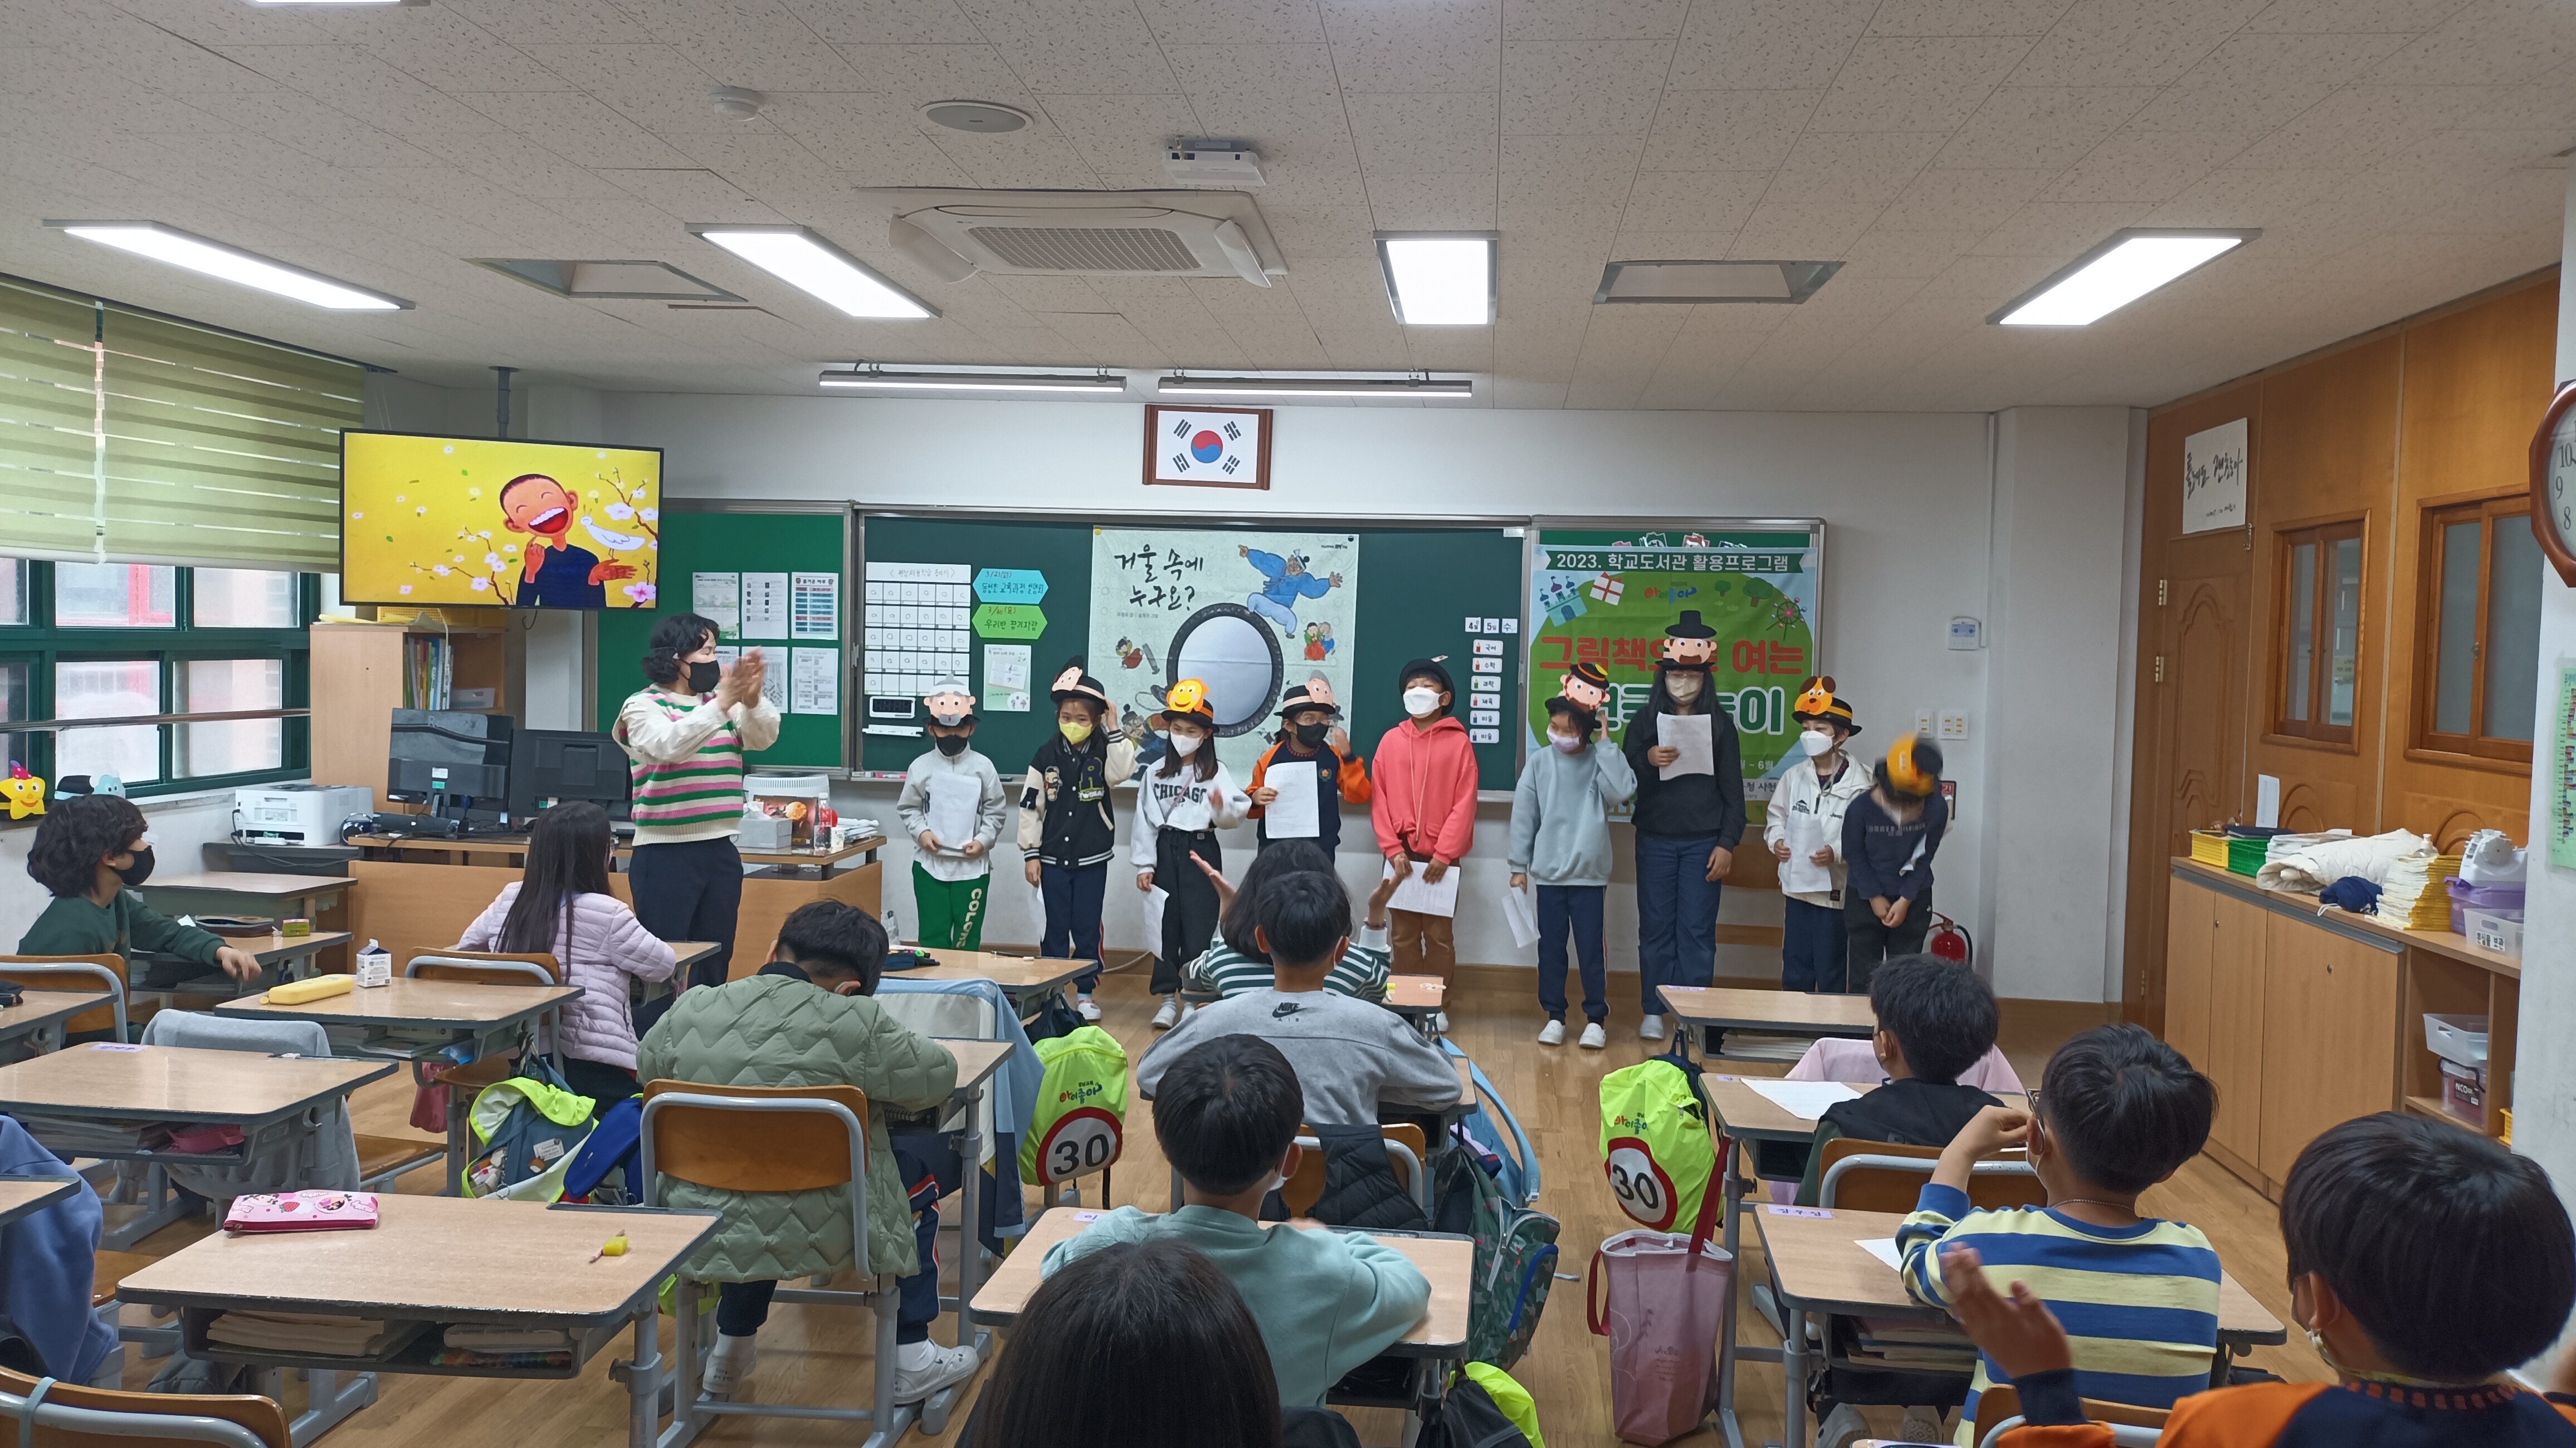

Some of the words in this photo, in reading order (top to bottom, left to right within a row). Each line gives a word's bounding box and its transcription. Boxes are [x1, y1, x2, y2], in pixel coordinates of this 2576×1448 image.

[2560, 443, 2572, 468] 10
[2186, 452, 2209, 500] 틀려도
[2213, 448, 2243, 486] 괜찮아
[2556, 476, 2563, 500] 9
[2564, 506, 2571, 530] 8
[1114, 544, 1158, 583] 거울
[1164, 549, 1203, 581] 속에
[1557, 554, 1602, 568] 2023.
[1608, 554, 1687, 570] 학교도서관
[1693, 555, 1788, 571] 활용프로그램
[1130, 585, 1194, 611] 누구요?
[984, 619, 1006, 629] 우리반
[1732, 639, 1803, 674] 여는
[1278, 1002, 1300, 1011] NIKE
[1060, 1084, 1102, 1104] 아이좋아
[1054, 1134, 1109, 1175] 30
[1613, 1164, 1658, 1209] 30
